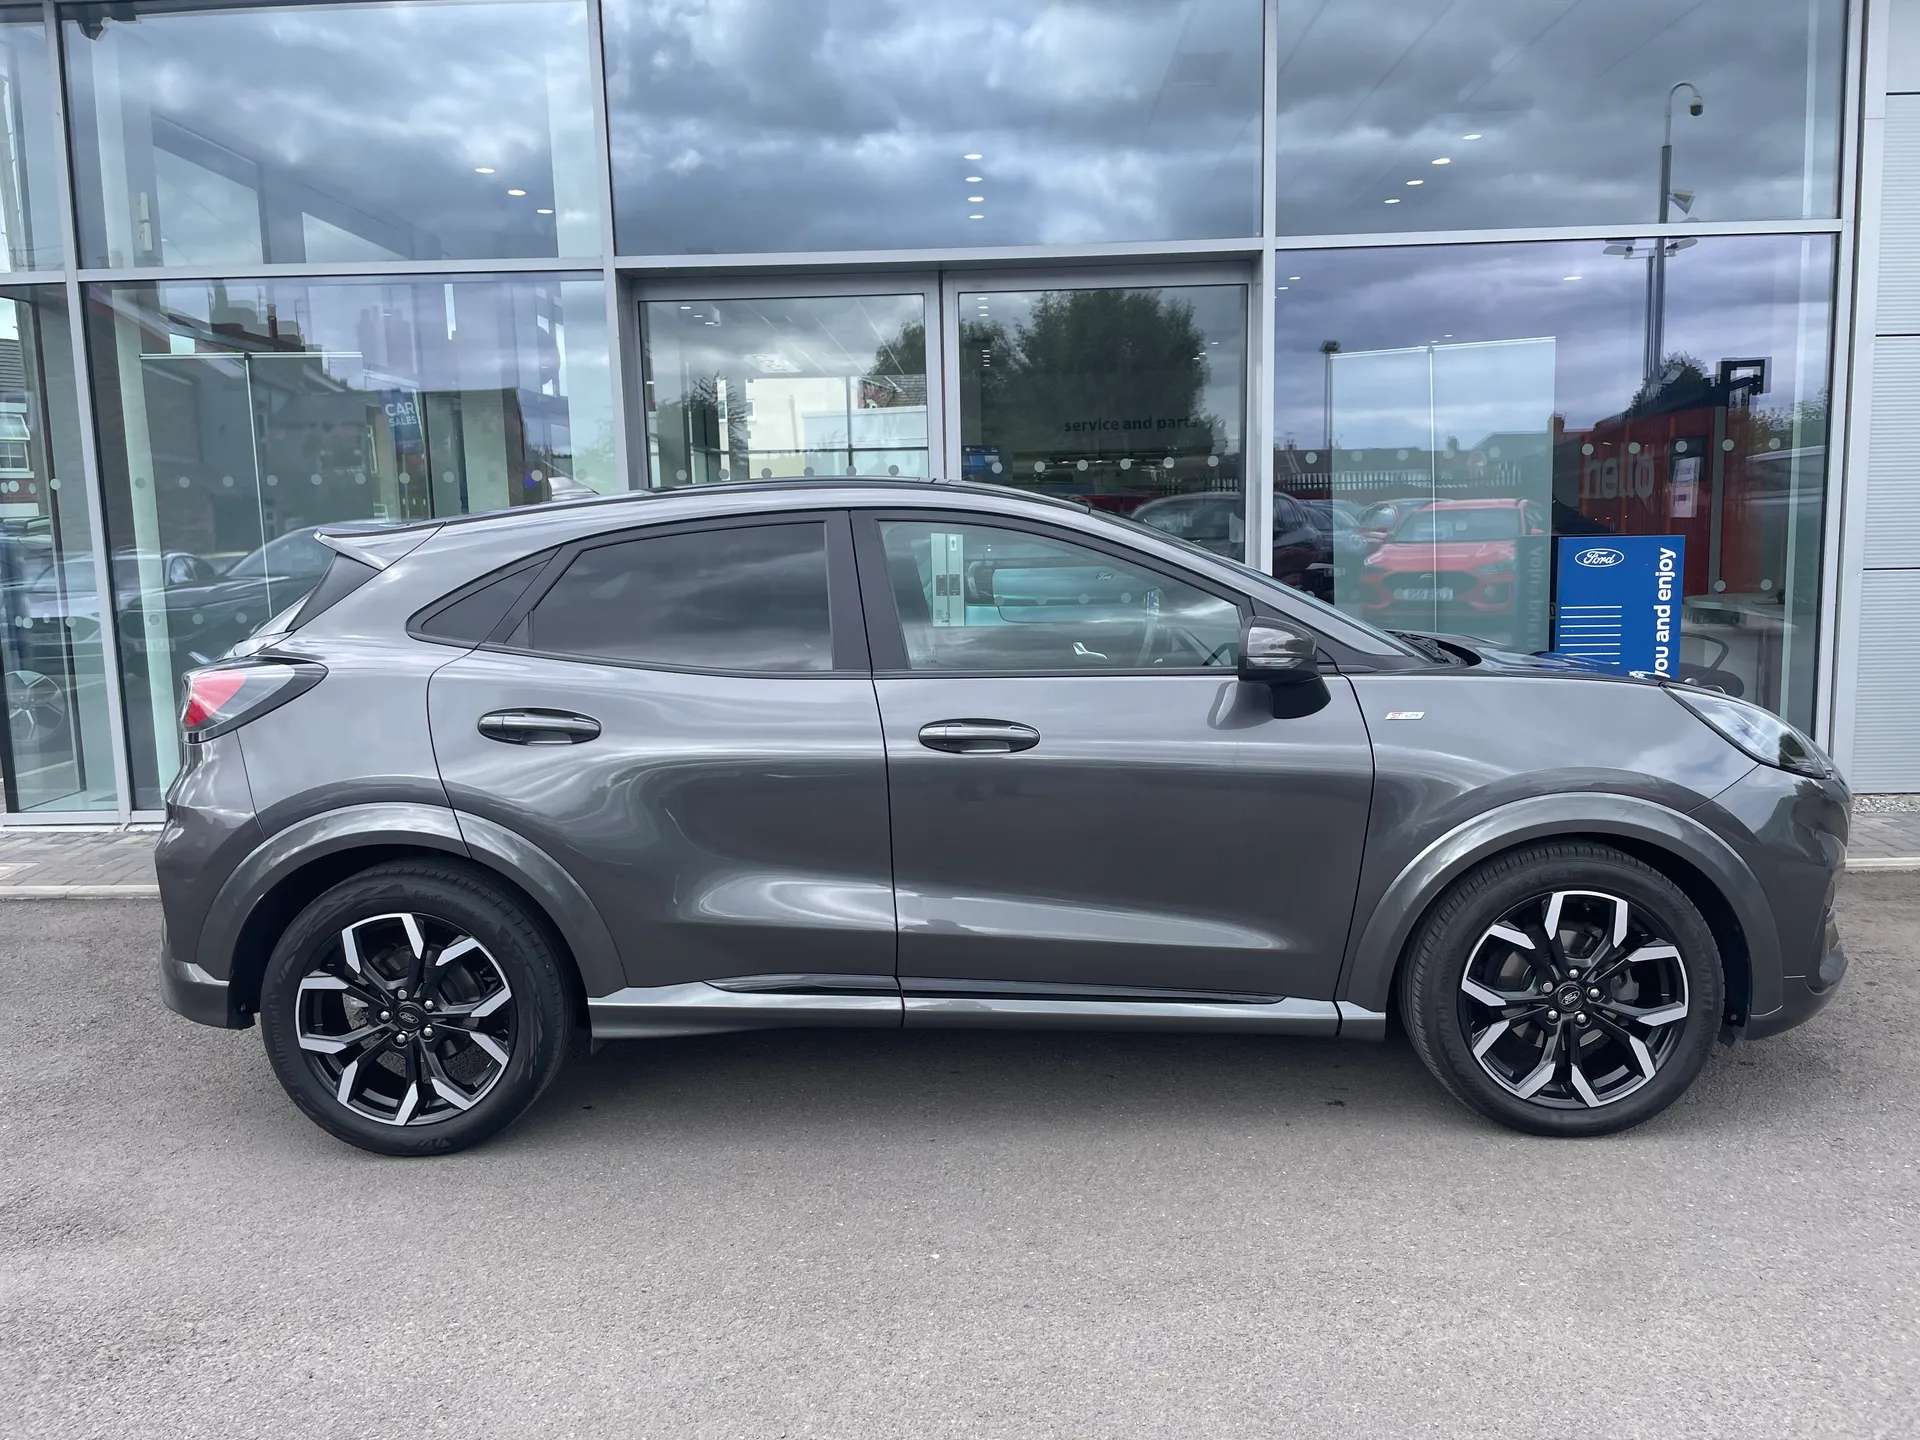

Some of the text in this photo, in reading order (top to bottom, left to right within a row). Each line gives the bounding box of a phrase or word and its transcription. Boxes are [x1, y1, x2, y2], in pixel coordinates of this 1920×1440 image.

[384, 402, 415, 416] CAR
[1063, 418, 1119, 432] service
[1122, 417, 1152, 430] and
[1582, 550, 1618, 566] Ford
[1655, 547, 1677, 601] enjoy
[1653, 604, 1671, 643] and
